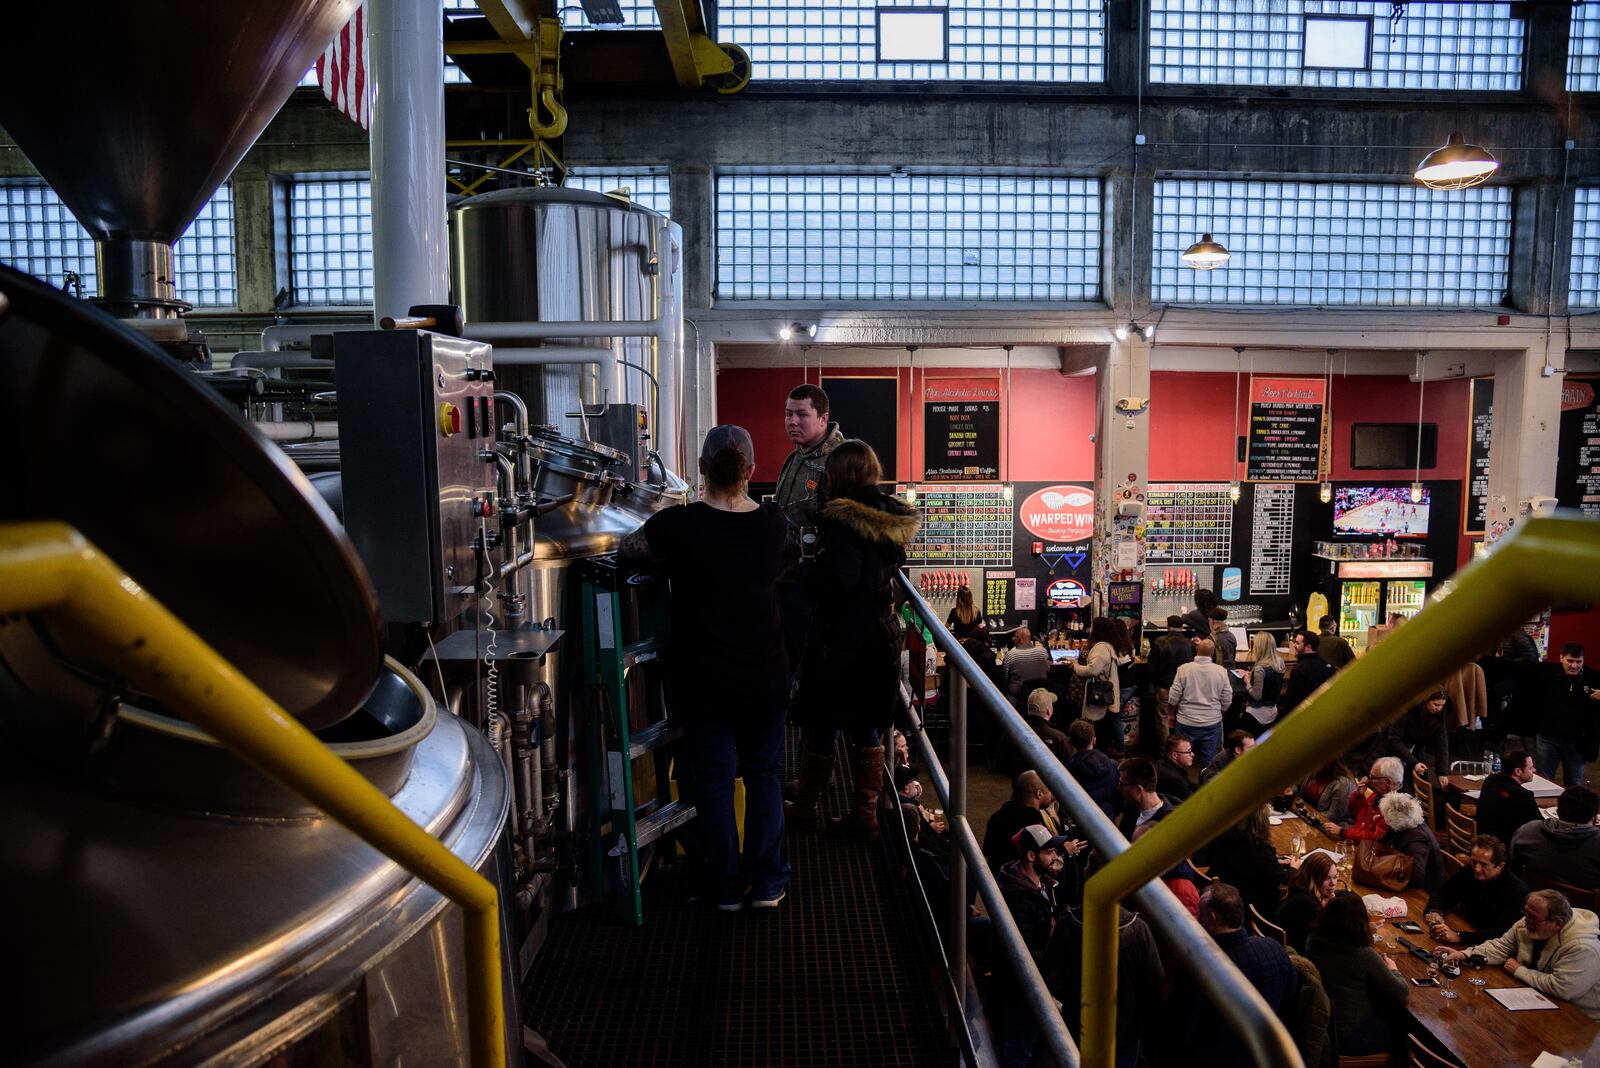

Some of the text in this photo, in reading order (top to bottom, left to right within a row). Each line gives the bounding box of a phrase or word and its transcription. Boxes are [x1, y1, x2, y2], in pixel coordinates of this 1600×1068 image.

[1029, 513, 1073, 527] WARPED
[1046, 543, 1089, 554] welcomes you!
